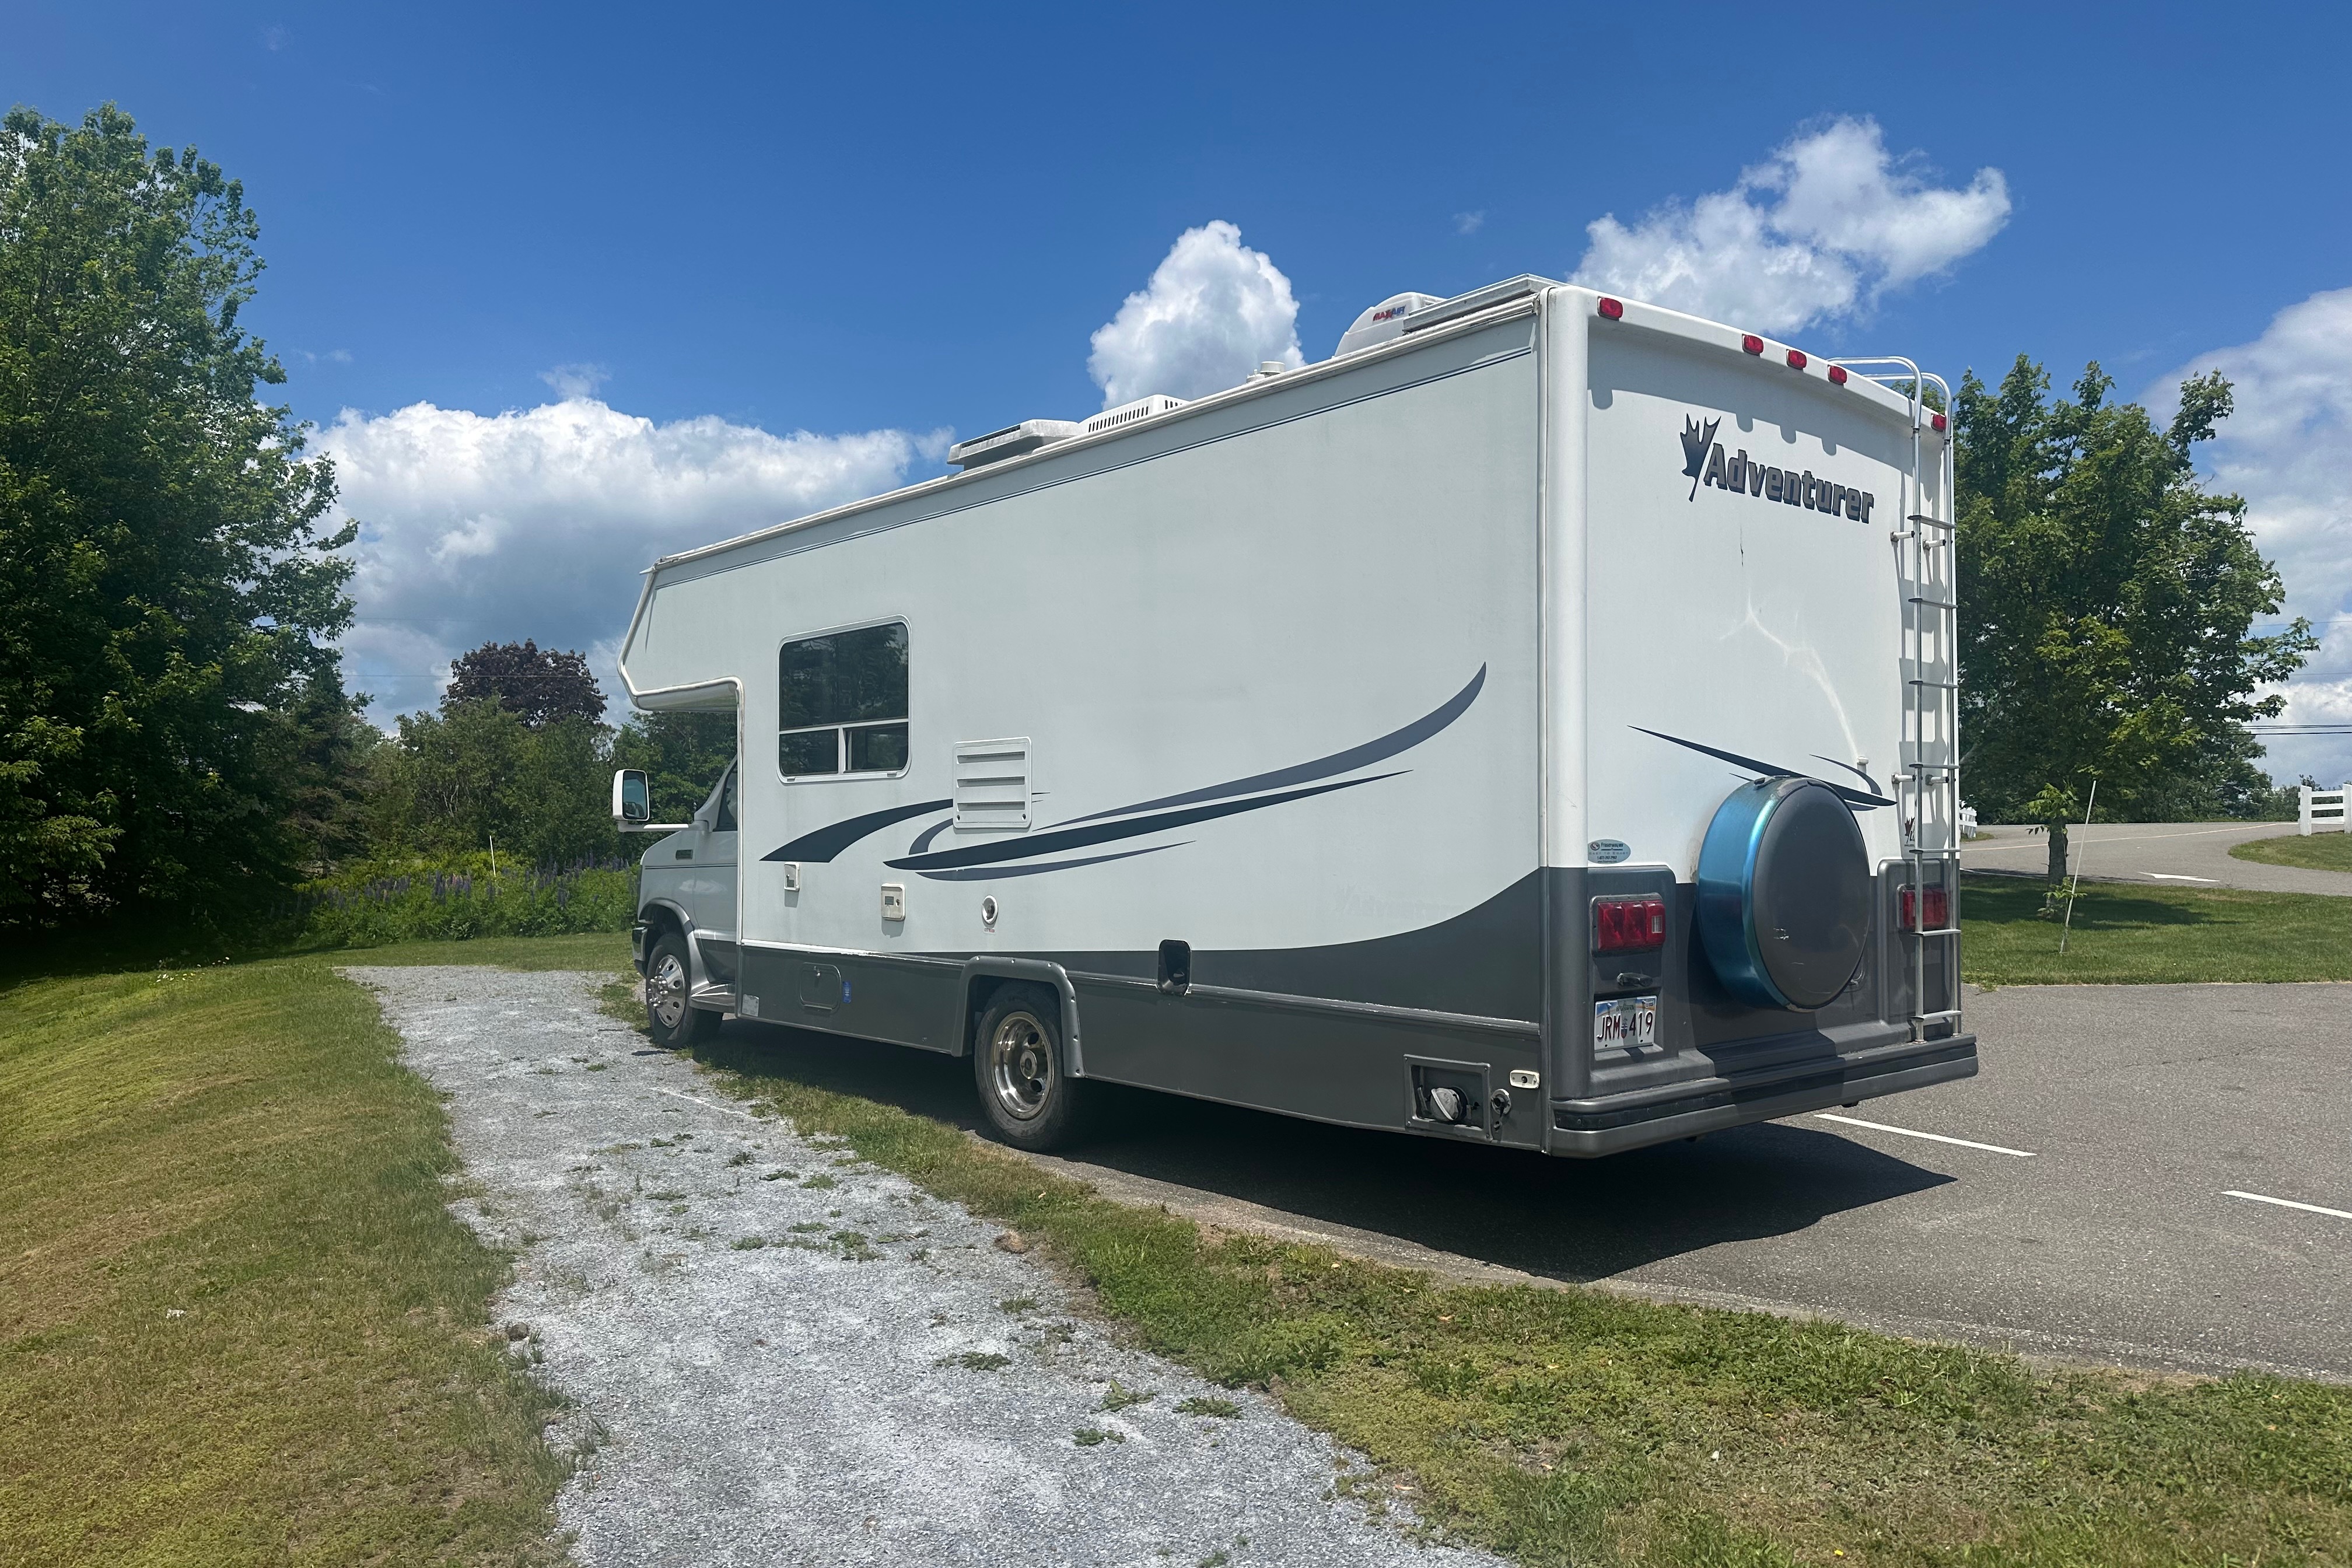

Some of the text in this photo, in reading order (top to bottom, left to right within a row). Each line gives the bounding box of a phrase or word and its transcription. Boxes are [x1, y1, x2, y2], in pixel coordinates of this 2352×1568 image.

[1703, 442, 1874, 524] Adventurer
[1596, 1011, 1653, 1041] JRM 419
